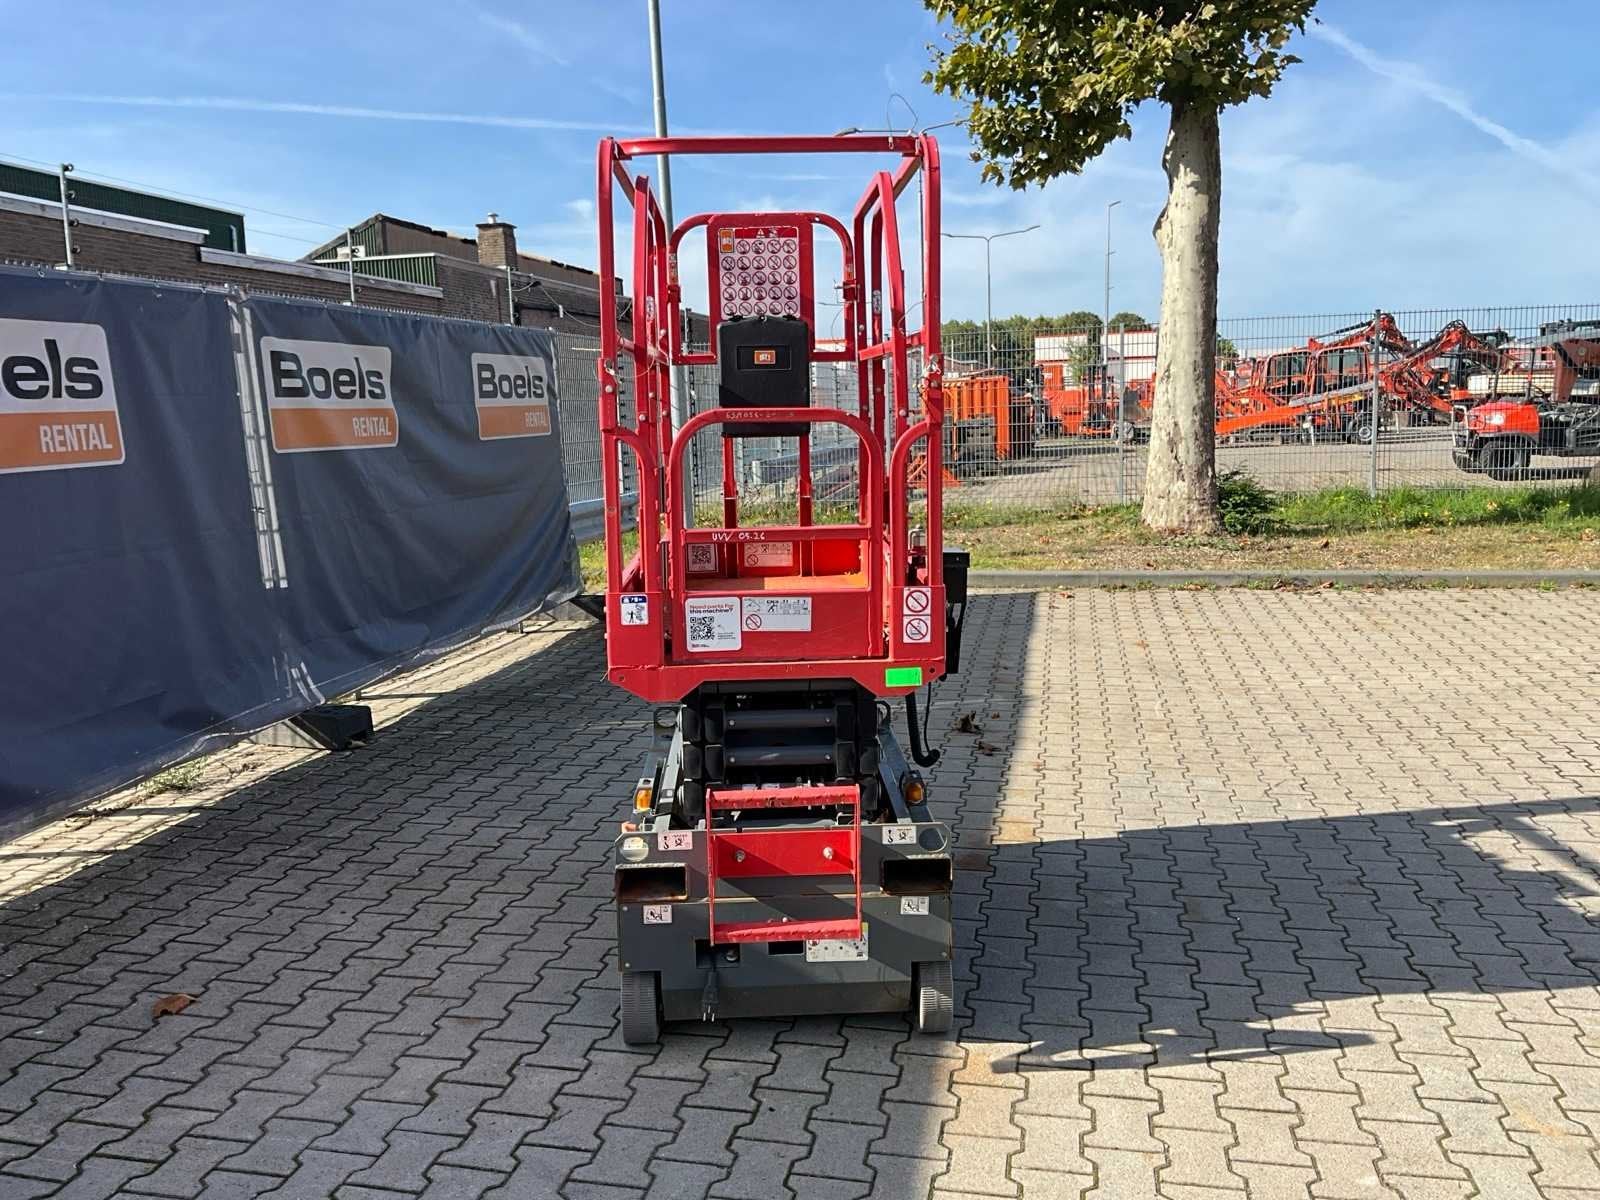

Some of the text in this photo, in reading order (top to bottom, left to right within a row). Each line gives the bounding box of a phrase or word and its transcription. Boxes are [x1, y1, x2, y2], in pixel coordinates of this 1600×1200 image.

[0, 338, 104, 400] els
[269, 350, 387, 400] Boels
[477, 363, 545, 399] Boels
[39, 422, 113, 453] RENTAL
[352, 416, 392, 437] RENTAL
